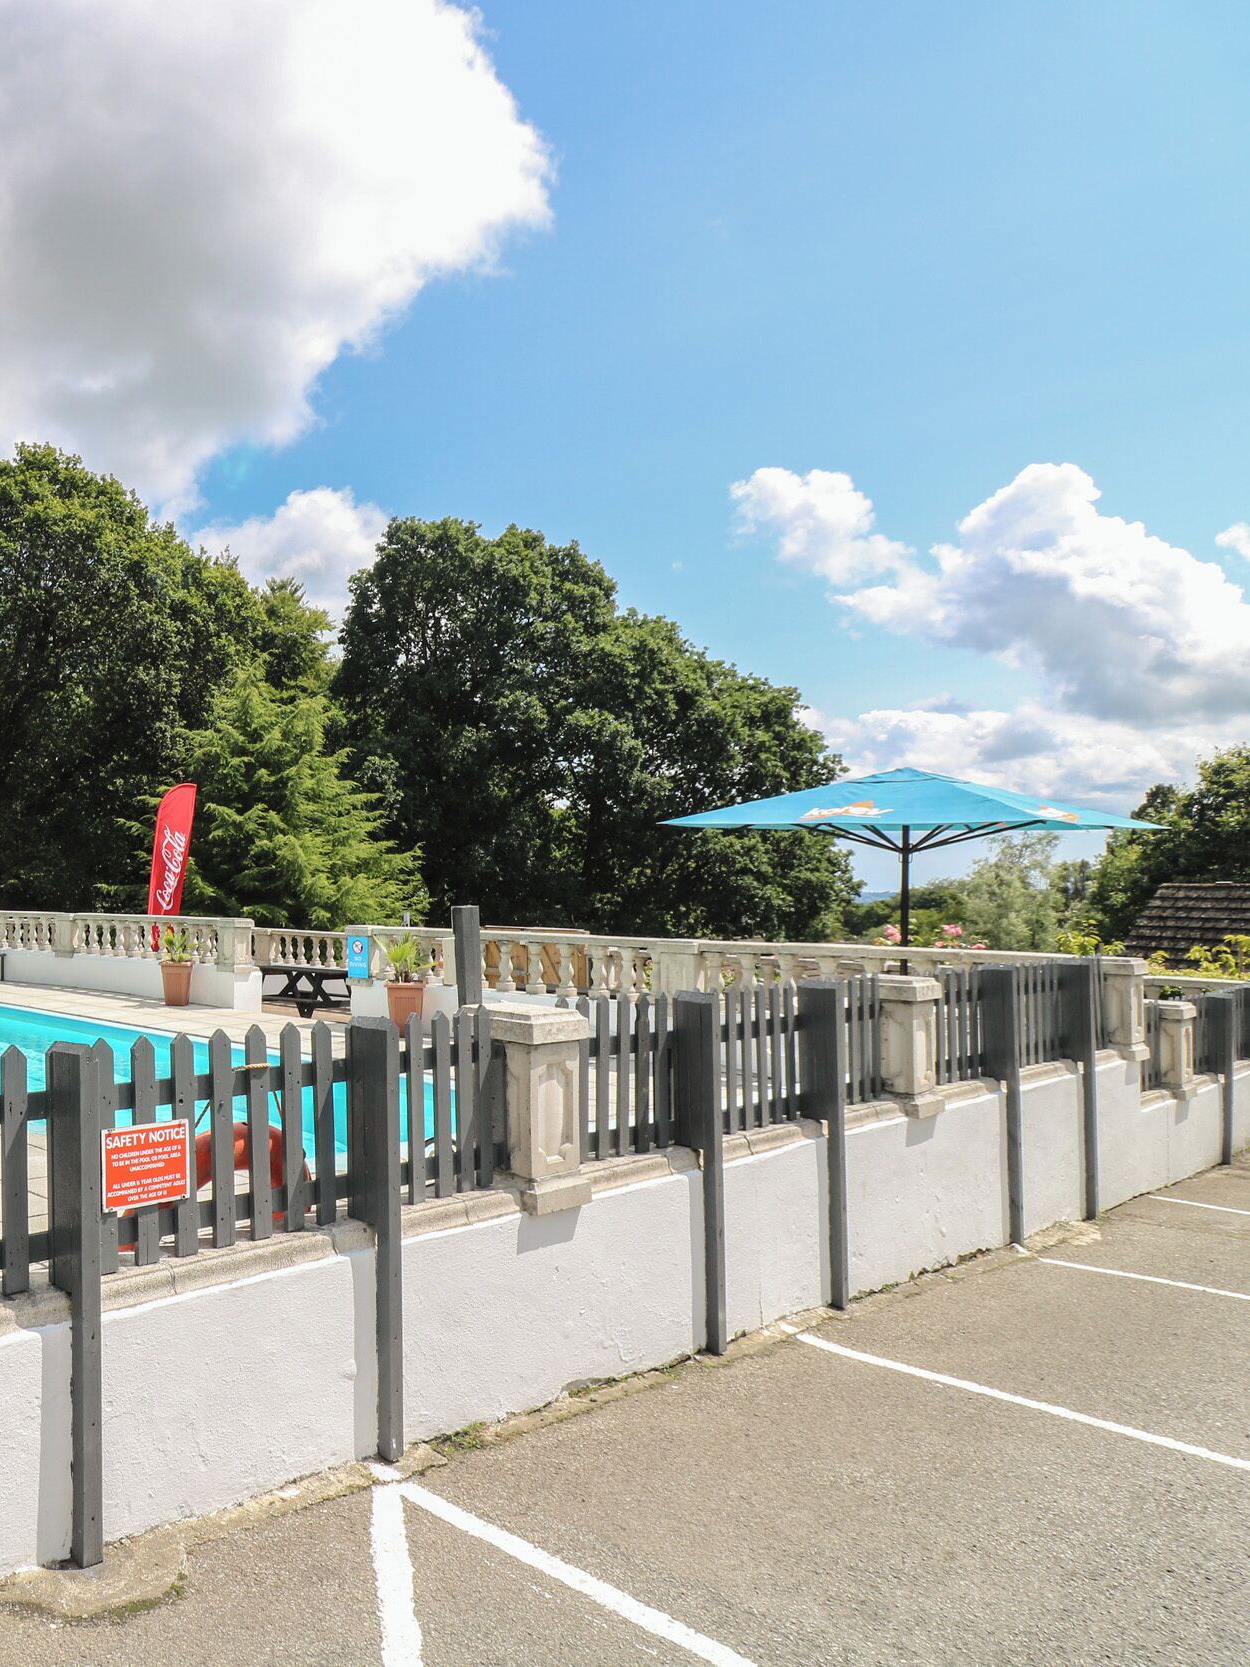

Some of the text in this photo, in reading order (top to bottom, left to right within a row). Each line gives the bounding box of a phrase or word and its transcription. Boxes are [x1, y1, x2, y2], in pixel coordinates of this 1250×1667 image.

[156, 825, 186, 910] Coca-Cola
[106, 1127, 185, 1149] SAFETY NOTICE
[119, 1150, 140, 1159] CHILDREN
